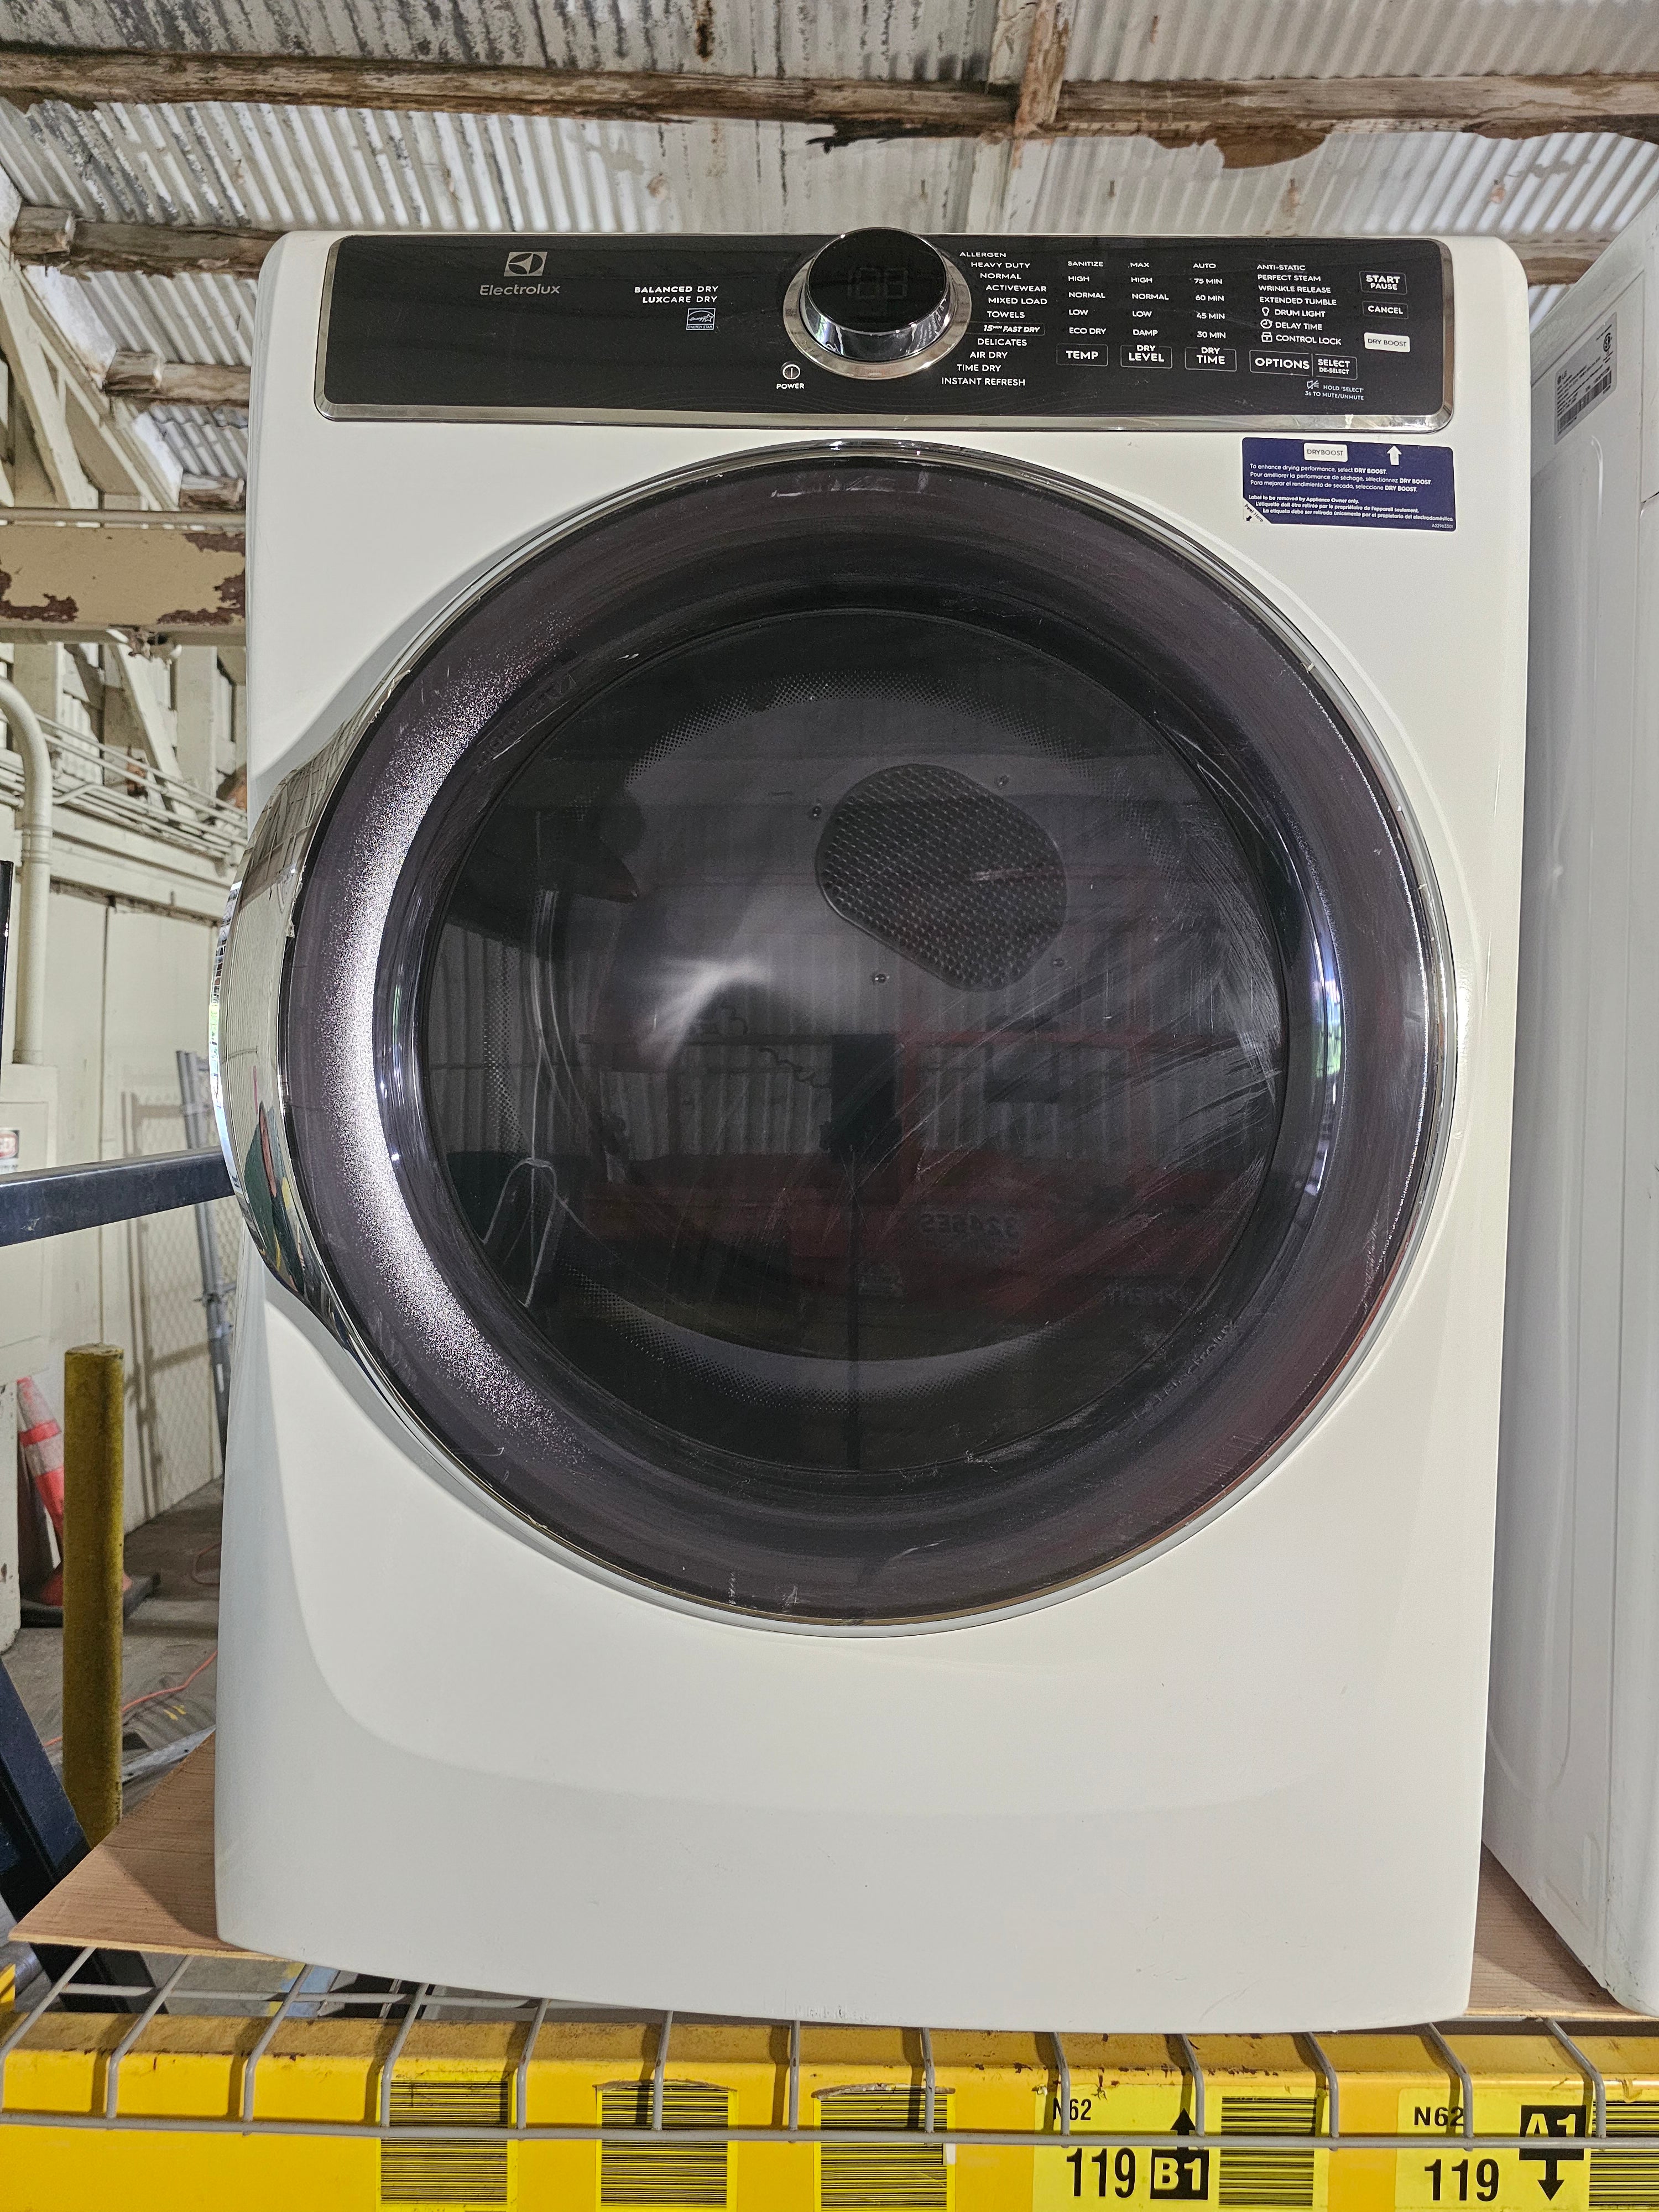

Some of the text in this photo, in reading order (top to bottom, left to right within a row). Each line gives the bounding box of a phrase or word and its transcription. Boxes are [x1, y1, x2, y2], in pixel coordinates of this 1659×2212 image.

[1366, 275, 1400, 284] START
[480, 284, 560, 295] Electrolux
[1368, 305, 1403, 314] CANCEL
[1276, 335, 1317, 343] CONTROL
[1066, 351, 1098, 359] TEMP
[1129, 352, 1164, 362] LEVEL
[1197, 355, 1225, 364] TIME
[1255, 358, 1310, 369] OPTIONS
[1318, 359, 1350, 368] SELECT
[1053, 2097, 1092, 2121] N62
[1414, 2106, 1464, 2126] N62
[1525, 2113, 1577, 2137] A1
[1066, 2147, 1136, 2198] 119
[1154, 2157, 1201, 2190] B1
[1424, 2158, 1499, 2202] 119
